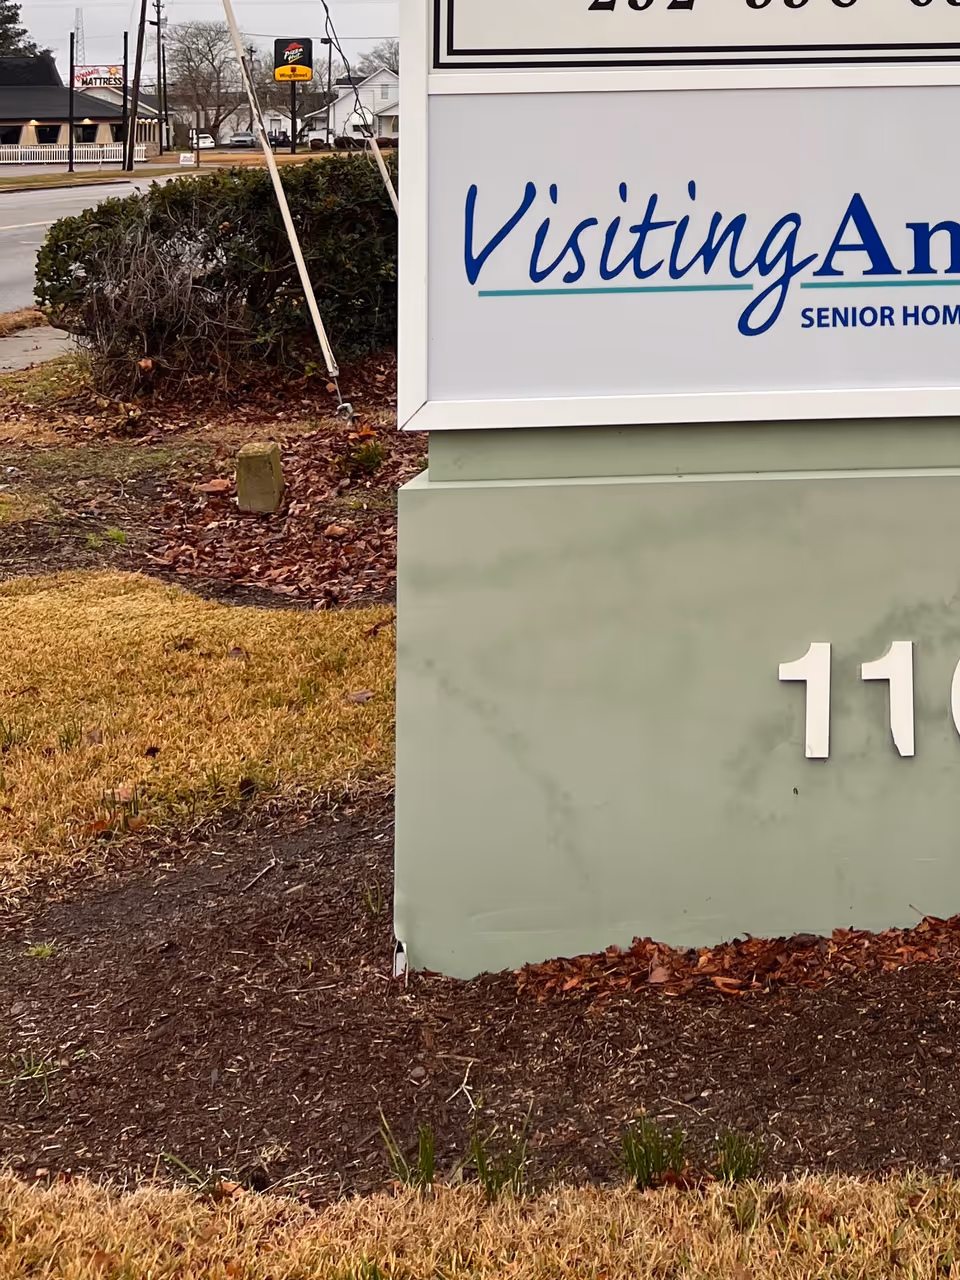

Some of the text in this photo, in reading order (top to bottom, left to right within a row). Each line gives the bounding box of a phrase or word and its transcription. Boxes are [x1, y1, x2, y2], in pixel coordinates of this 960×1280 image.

[283, 47, 304, 60] Pizza
[81, 76, 122, 86] MATTRESS
[464, 180, 818, 337] Visiting
[801, 306, 895, 328] SENIOR
